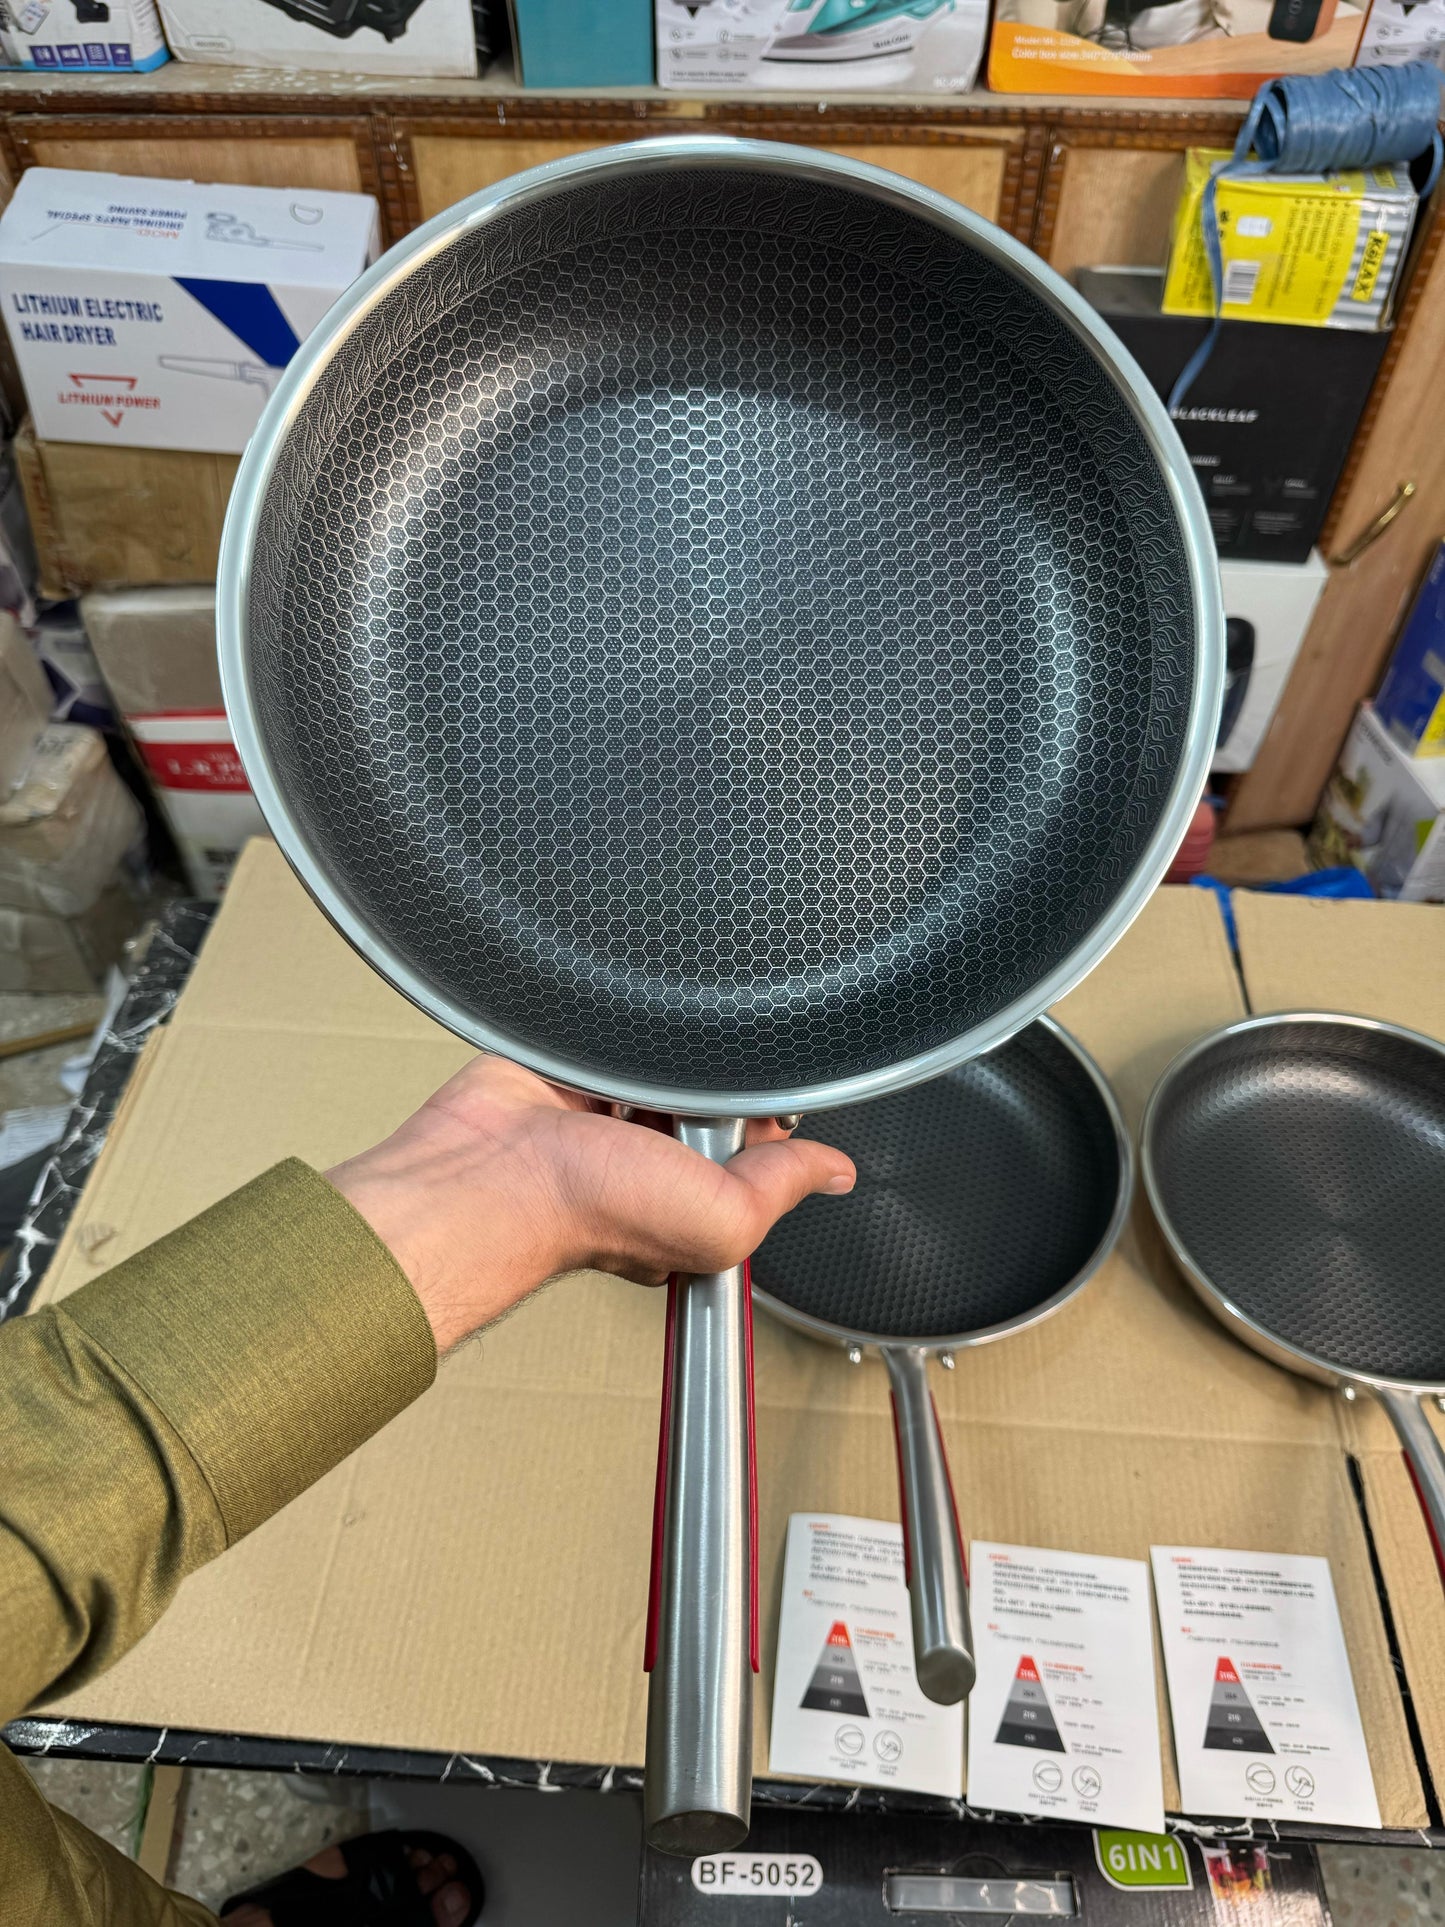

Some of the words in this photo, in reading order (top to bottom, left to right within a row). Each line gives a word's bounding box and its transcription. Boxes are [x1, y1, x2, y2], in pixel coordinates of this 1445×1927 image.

[12, 293, 83, 317] LITHIUM
[85, 296, 164, 323] ELECTRIC
[20, 321, 63, 343] HAIR
[62, 324, 117, 346] DRYER
[58, 391, 113, 407] LITHIUM
[115, 394, 161, 410] POWER
[1108, 1841, 1181, 1873] 6IN1
[699, 1860, 816, 1887] BF-5052
